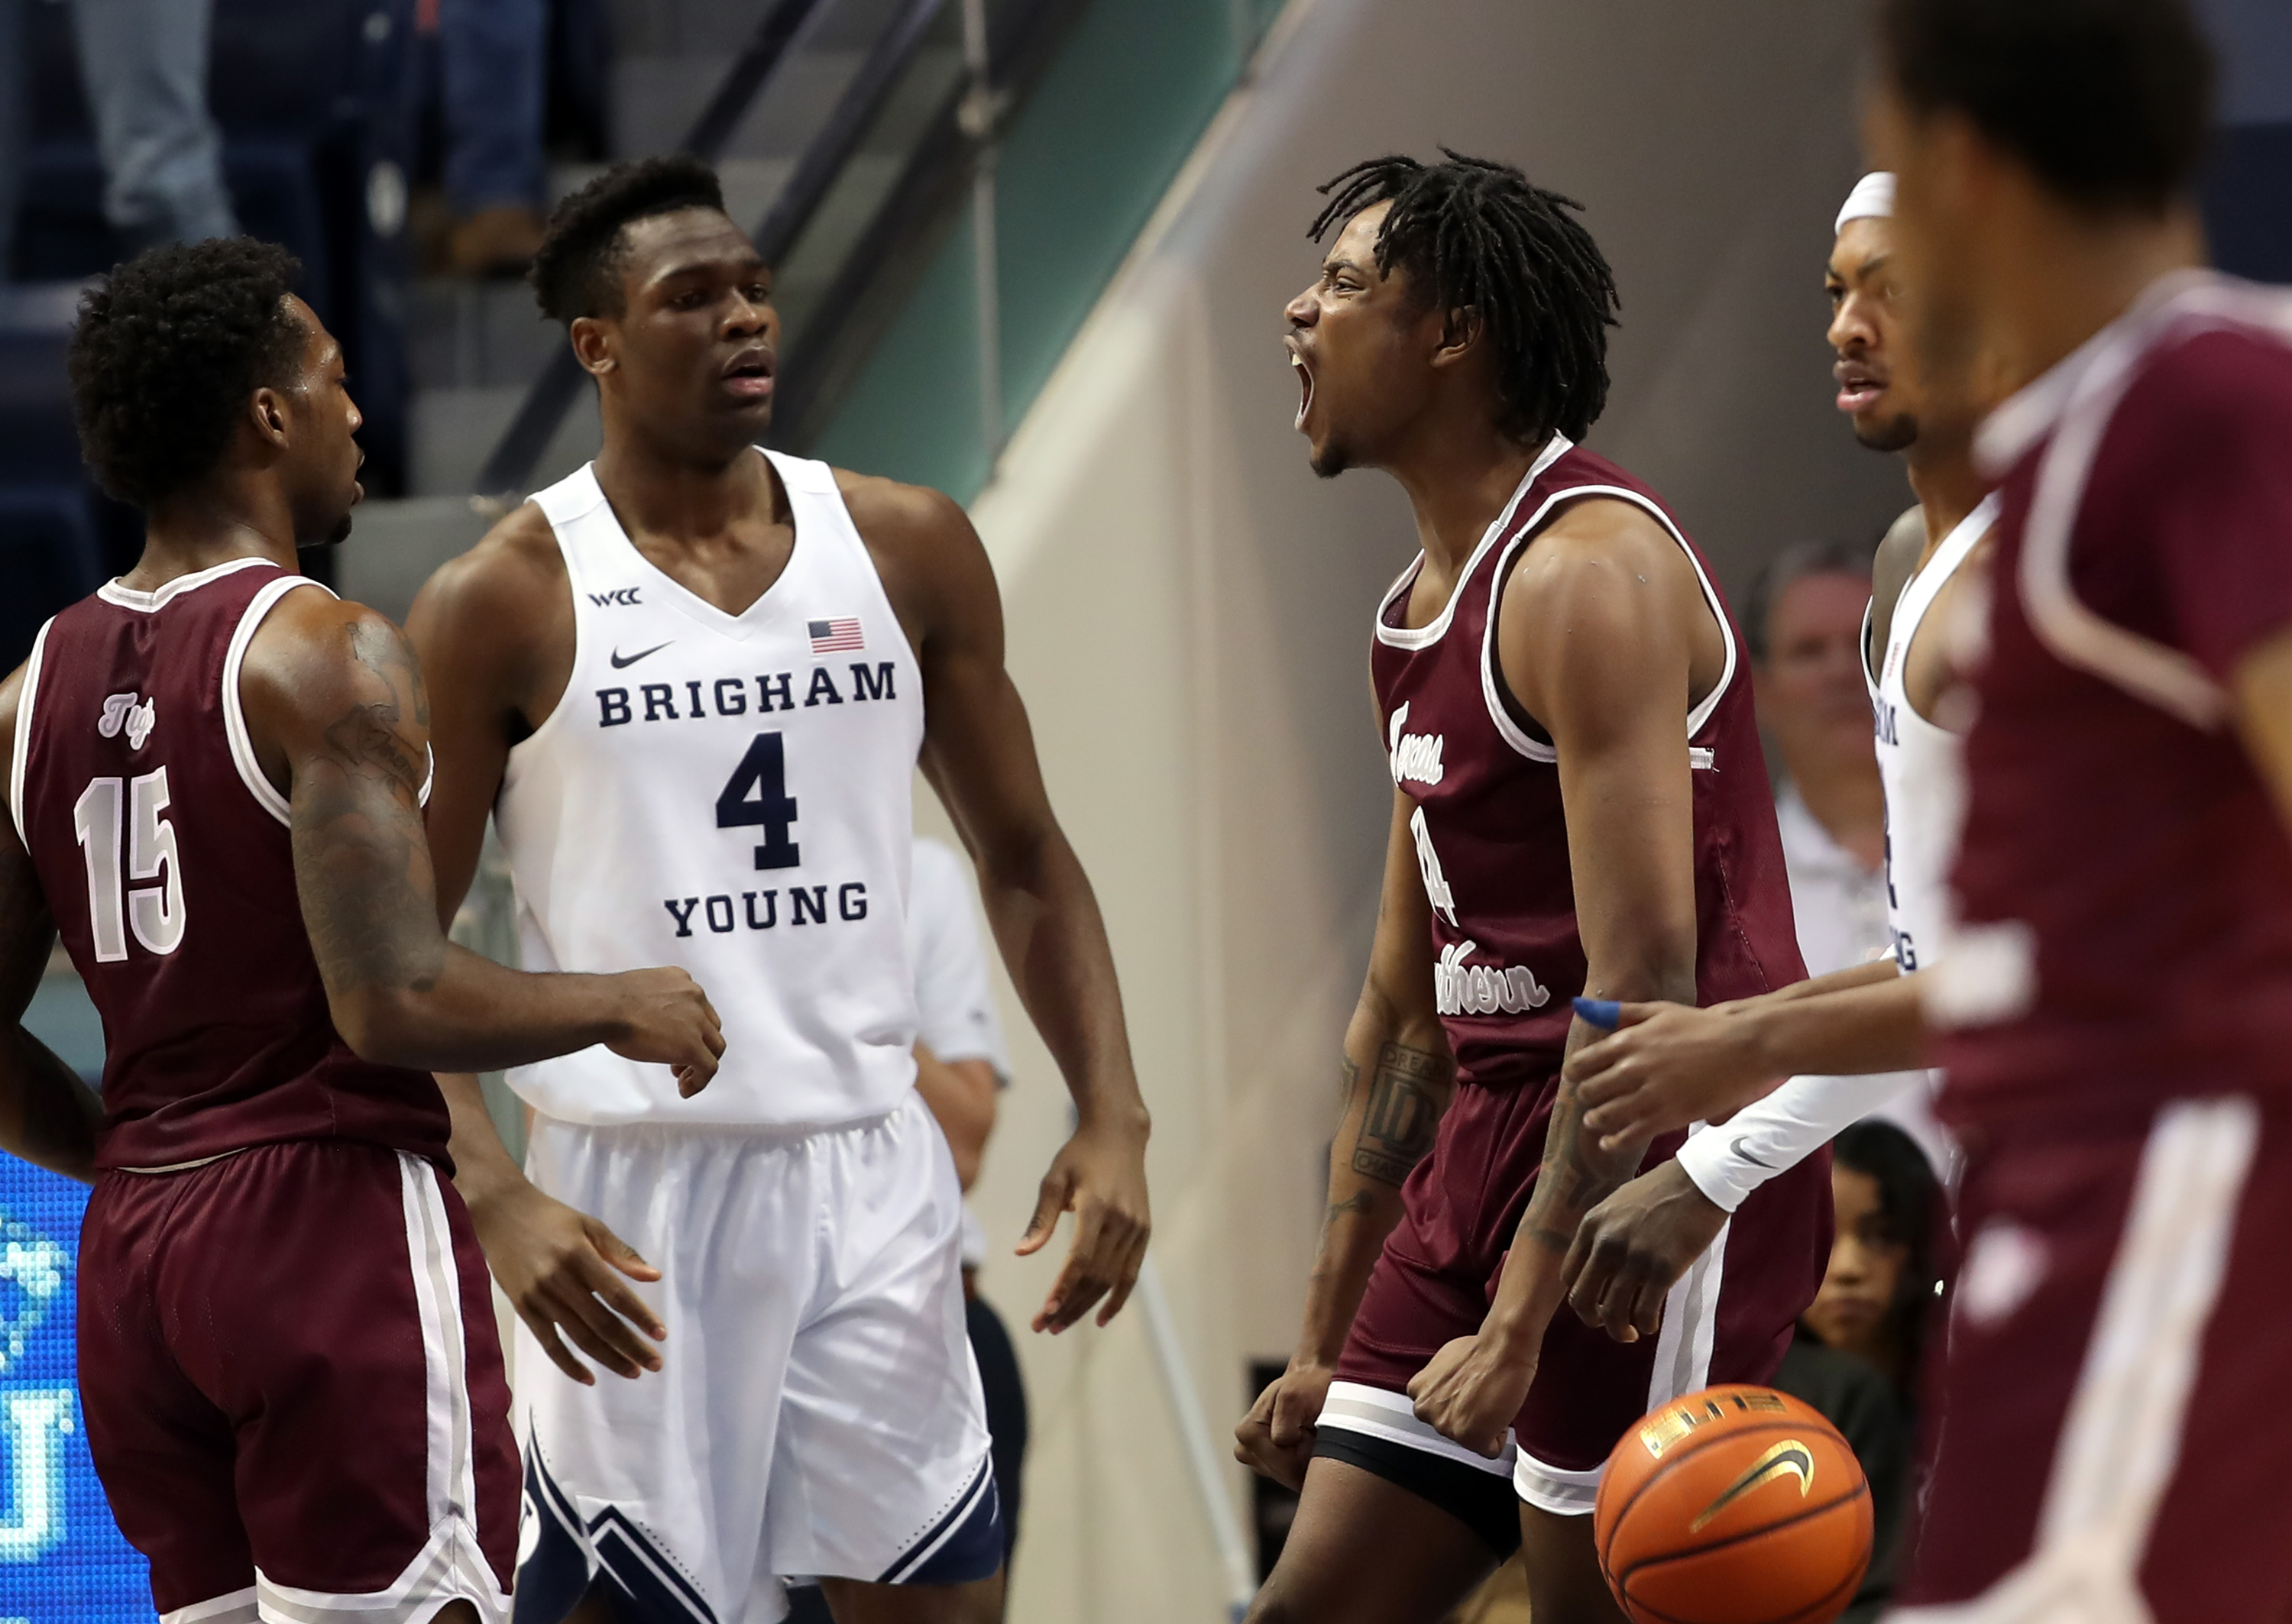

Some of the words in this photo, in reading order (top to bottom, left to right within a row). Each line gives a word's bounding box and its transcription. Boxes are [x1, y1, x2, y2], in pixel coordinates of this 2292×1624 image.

[587, 586, 643, 608] WCC
[596, 662, 896, 727] BRIGHAM
[715, 730, 800, 870] 4
[73, 765, 186, 962] 15
[664, 882, 869, 937] YOUNG
